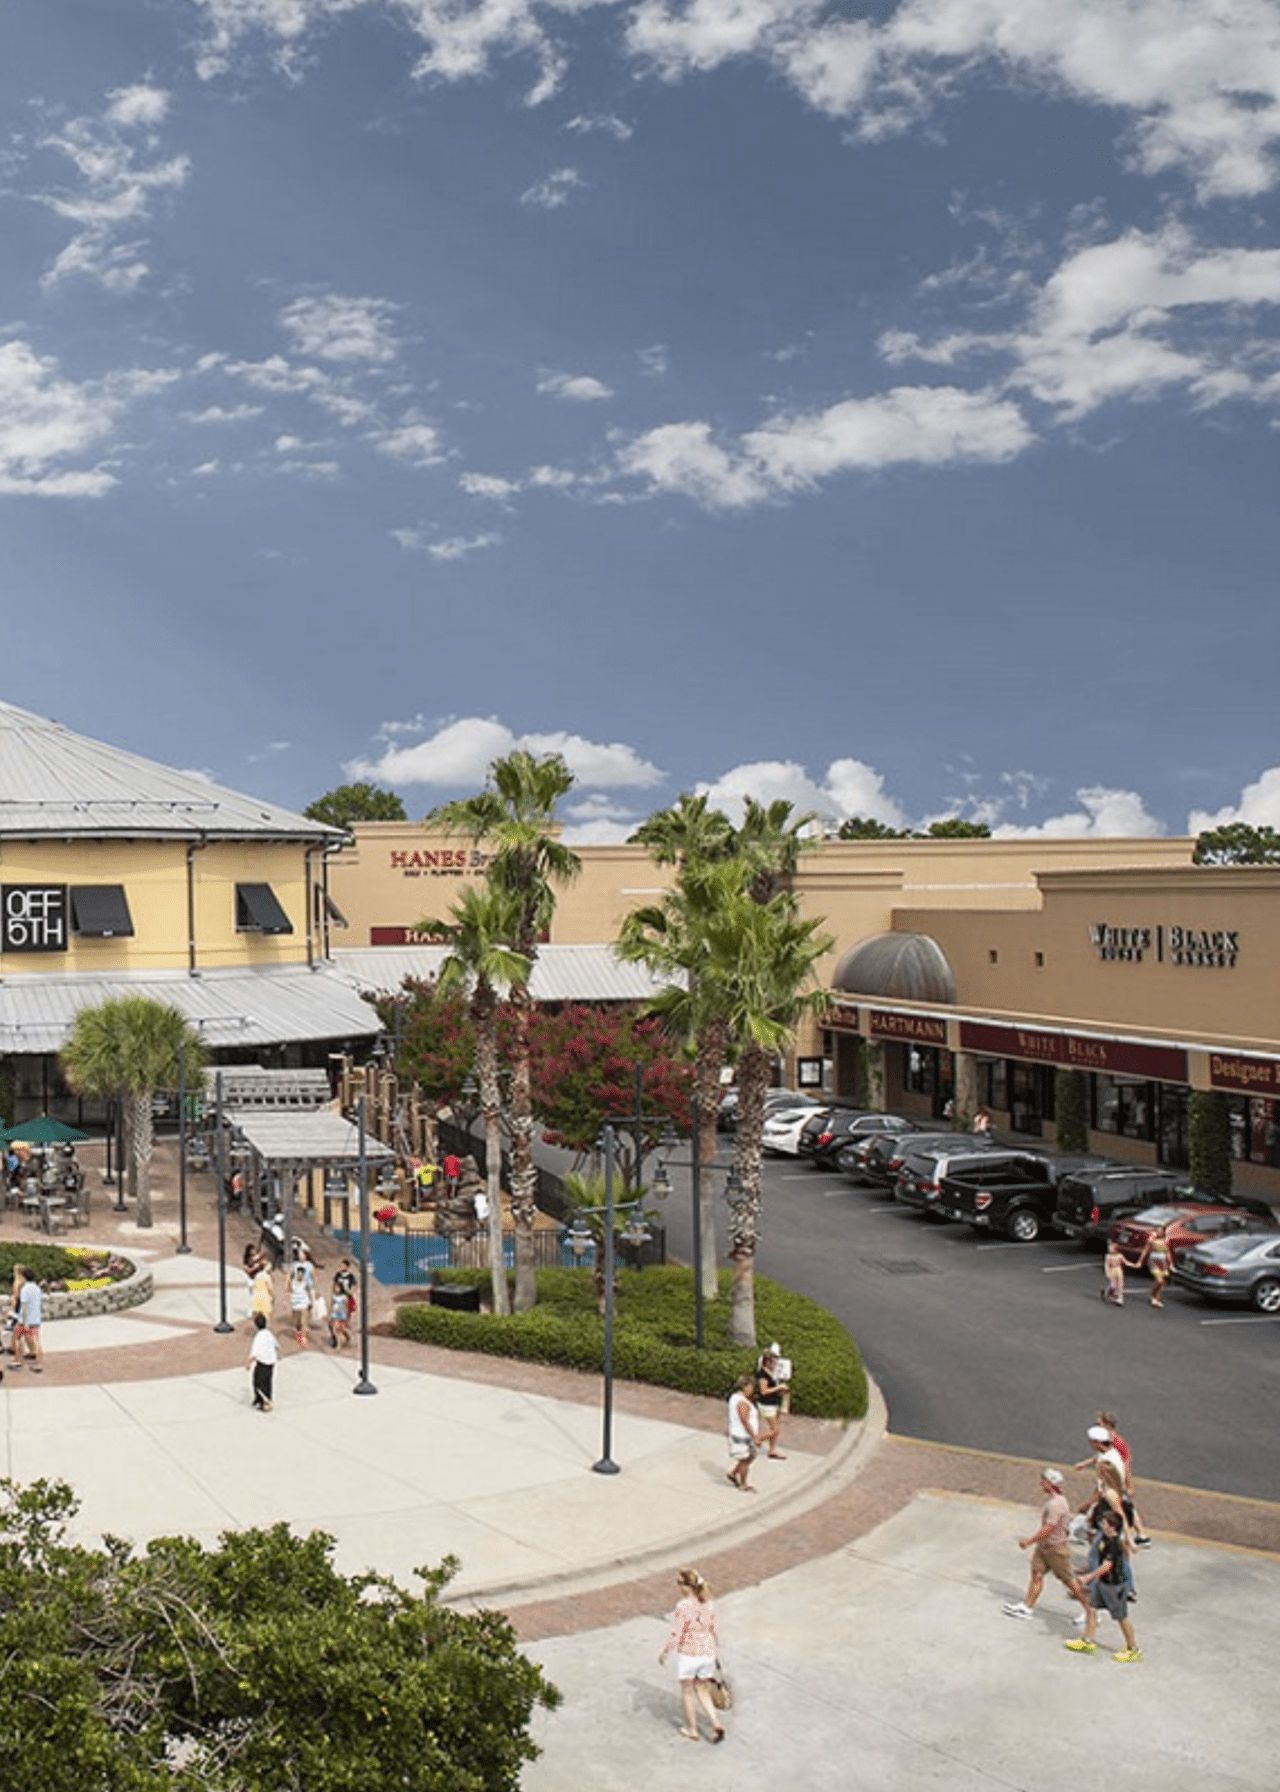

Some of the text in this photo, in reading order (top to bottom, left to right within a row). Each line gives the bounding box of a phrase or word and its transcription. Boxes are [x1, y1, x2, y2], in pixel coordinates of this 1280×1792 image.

[390, 849, 466, 868] HANES
[6, 889, 61, 918] OFF
[6, 916, 62, 945] 5TH
[1170, 925, 1239, 952] BLACK
[871, 1013, 945, 1040] HARTMANN
[1211, 1054, 1271, 1085] Designer
